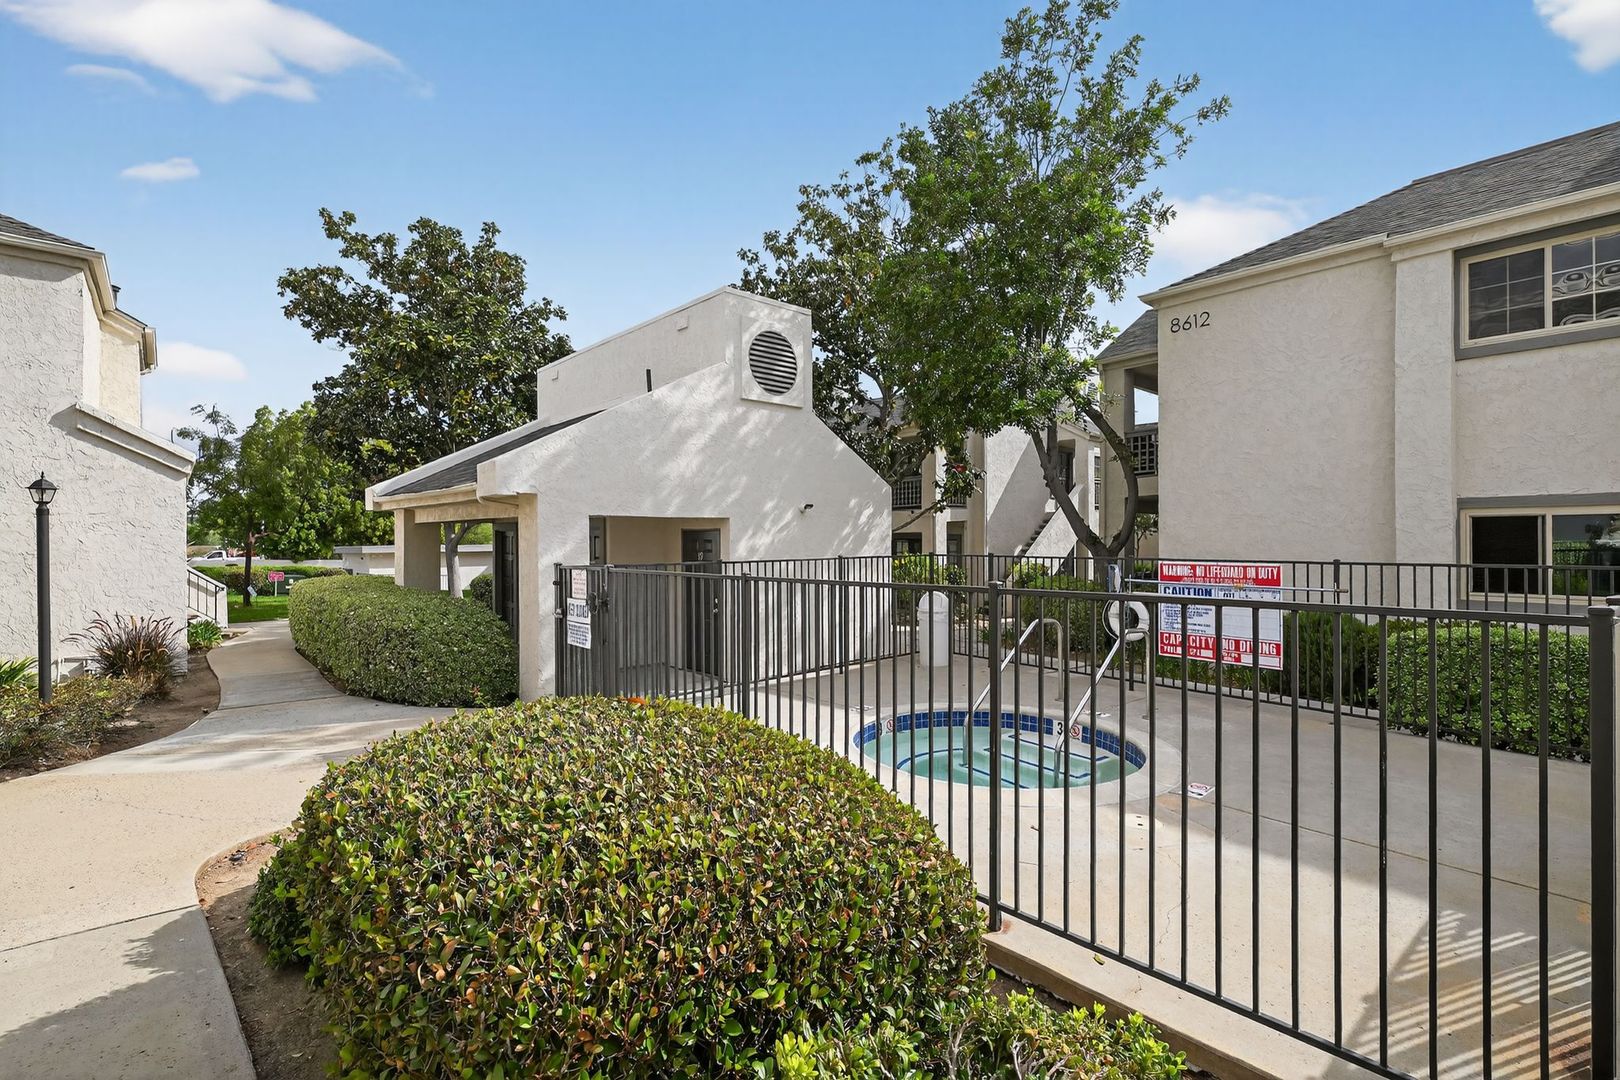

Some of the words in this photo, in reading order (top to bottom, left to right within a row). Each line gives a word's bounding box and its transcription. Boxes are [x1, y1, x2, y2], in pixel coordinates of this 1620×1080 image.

[1170, 311, 1210, 333] 8612
[1196, 565, 1205, 577] NO
[1206, 565, 1244, 578] LIFEGUARD
[1247, 566, 1256, 579] ON
[1258, 567, 1278, 580] DUTY
[1163, 586, 1212, 598] CAUTION
[1163, 633, 1214, 649] CAPCITY
[1222, 638, 1235, 650] NO
[1239, 640, 1277, 655] DIING
[1057, 721, 1063, 736] 3
